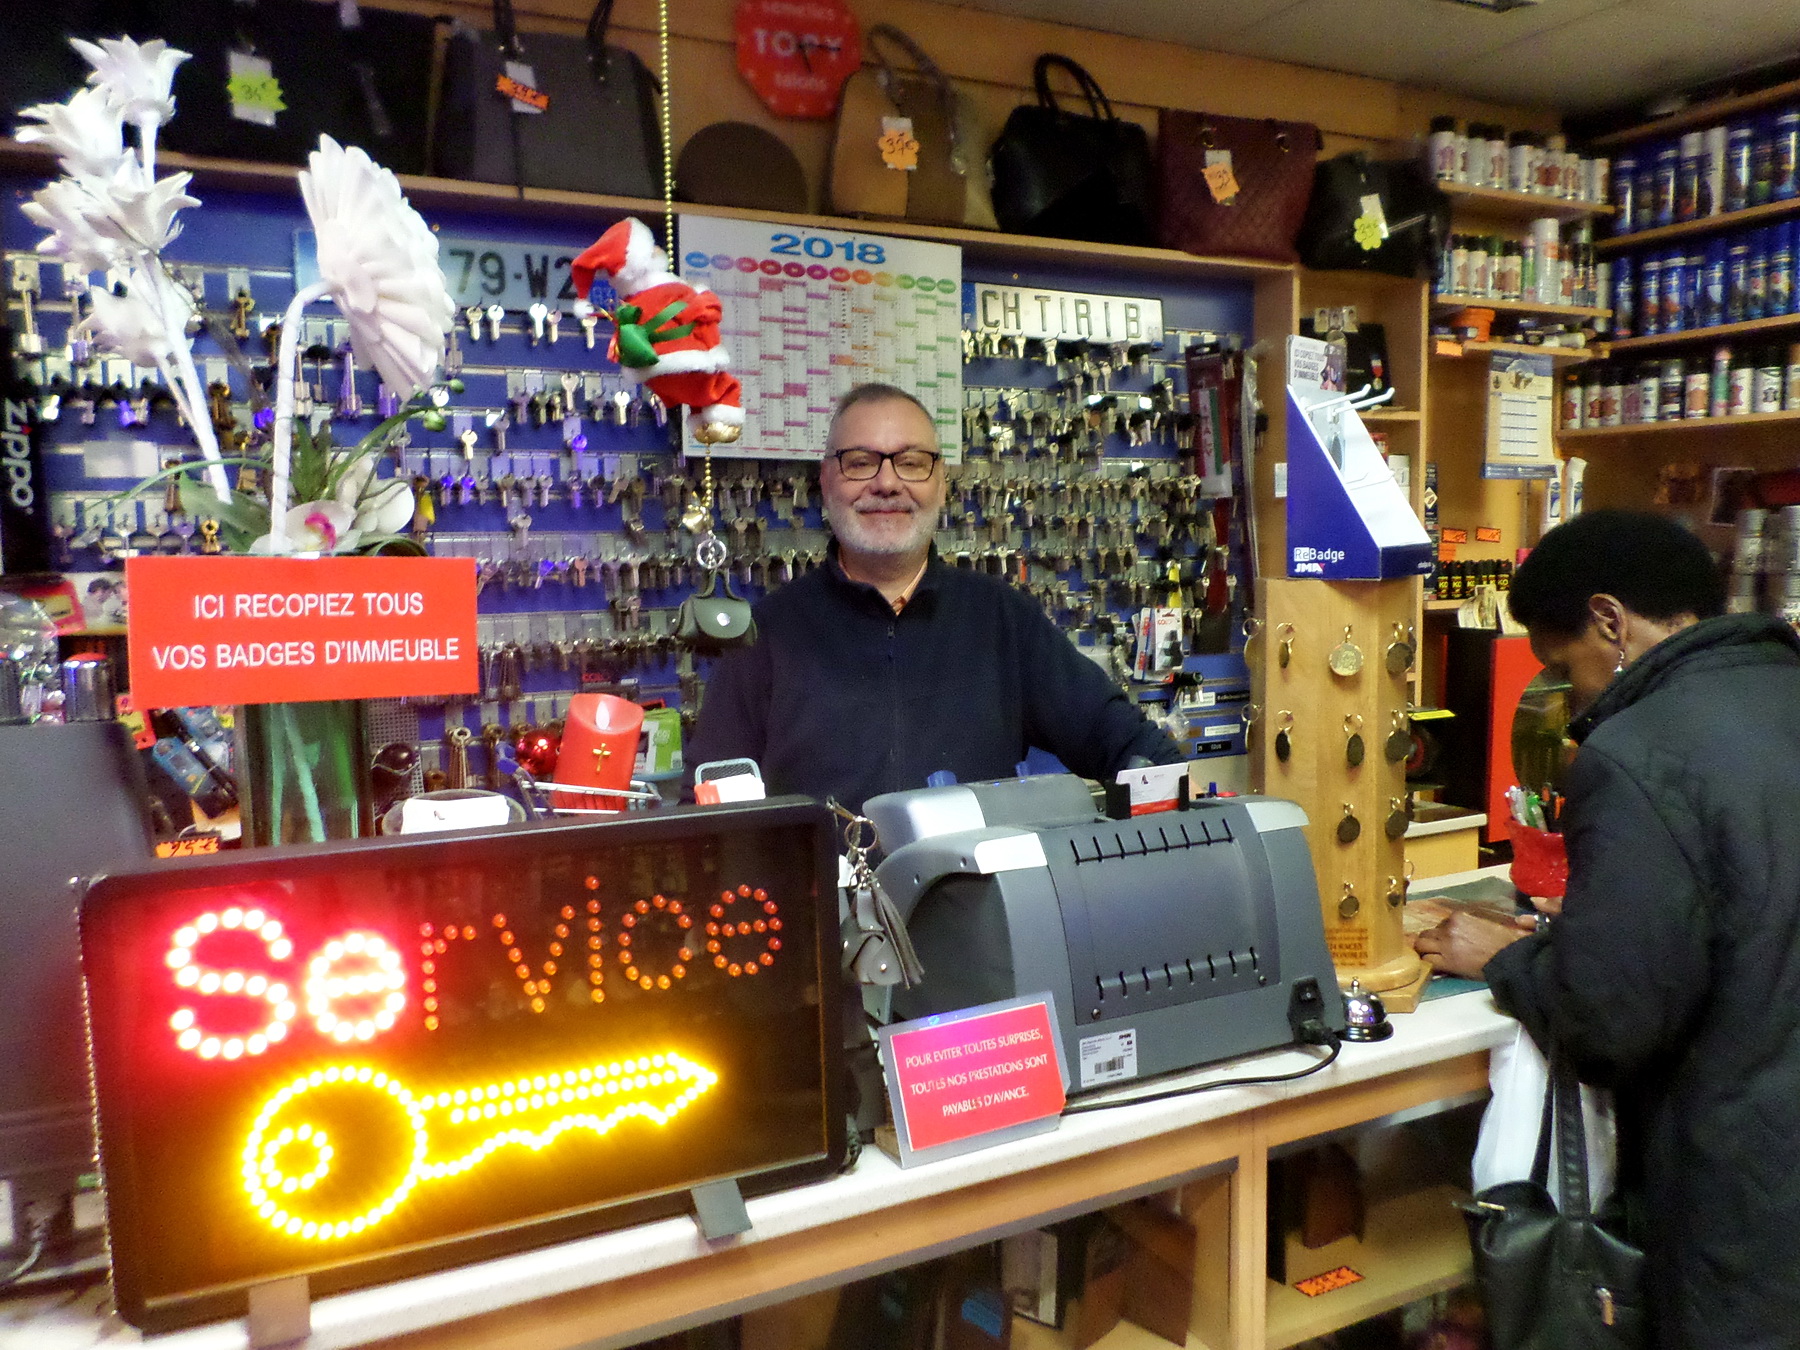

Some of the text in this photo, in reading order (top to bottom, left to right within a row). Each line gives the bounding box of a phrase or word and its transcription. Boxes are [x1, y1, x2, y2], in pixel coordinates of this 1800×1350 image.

[770, 233, 887, 265] 2018
[1294, 547, 1346, 563] ReBadge
[193, 591, 424, 619] ICI RECOPIEZ TOUS
[152, 637, 460, 670] VOS BADGES D'IMMEUBLE
[166, 875, 784, 1062] Service
[905, 1028, 1044, 1069] POUR EVITER TOUTES SURPRISES,
[947, 1072, 967, 1087] NOS
[969, 1059, 1024, 1083] PRESTATIONS
[1024, 1053, 1048, 1070] SONT
